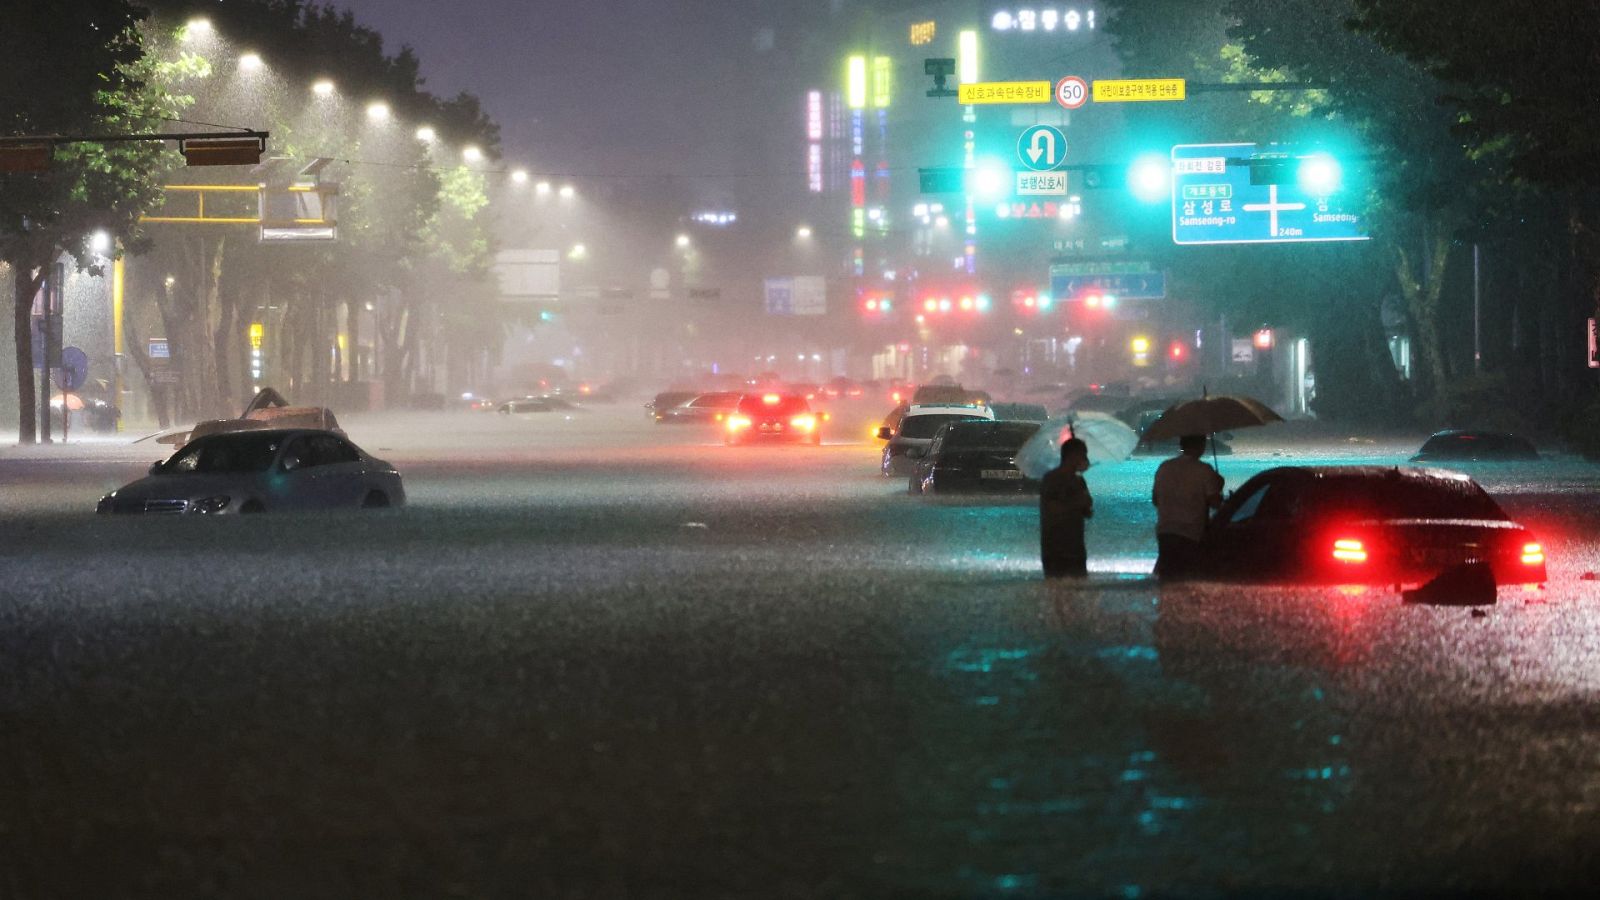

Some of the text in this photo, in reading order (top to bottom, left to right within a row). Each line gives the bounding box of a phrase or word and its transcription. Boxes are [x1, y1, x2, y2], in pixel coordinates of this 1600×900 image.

[966, 86, 1044, 99] 신호과속단속장비
[1063, 86, 1082, 99] 50
[1020, 176, 1064, 190] 보행신호시
[1179, 216, 1236, 226] Samseong-ro
[1279, 228, 1303, 237] 240m
